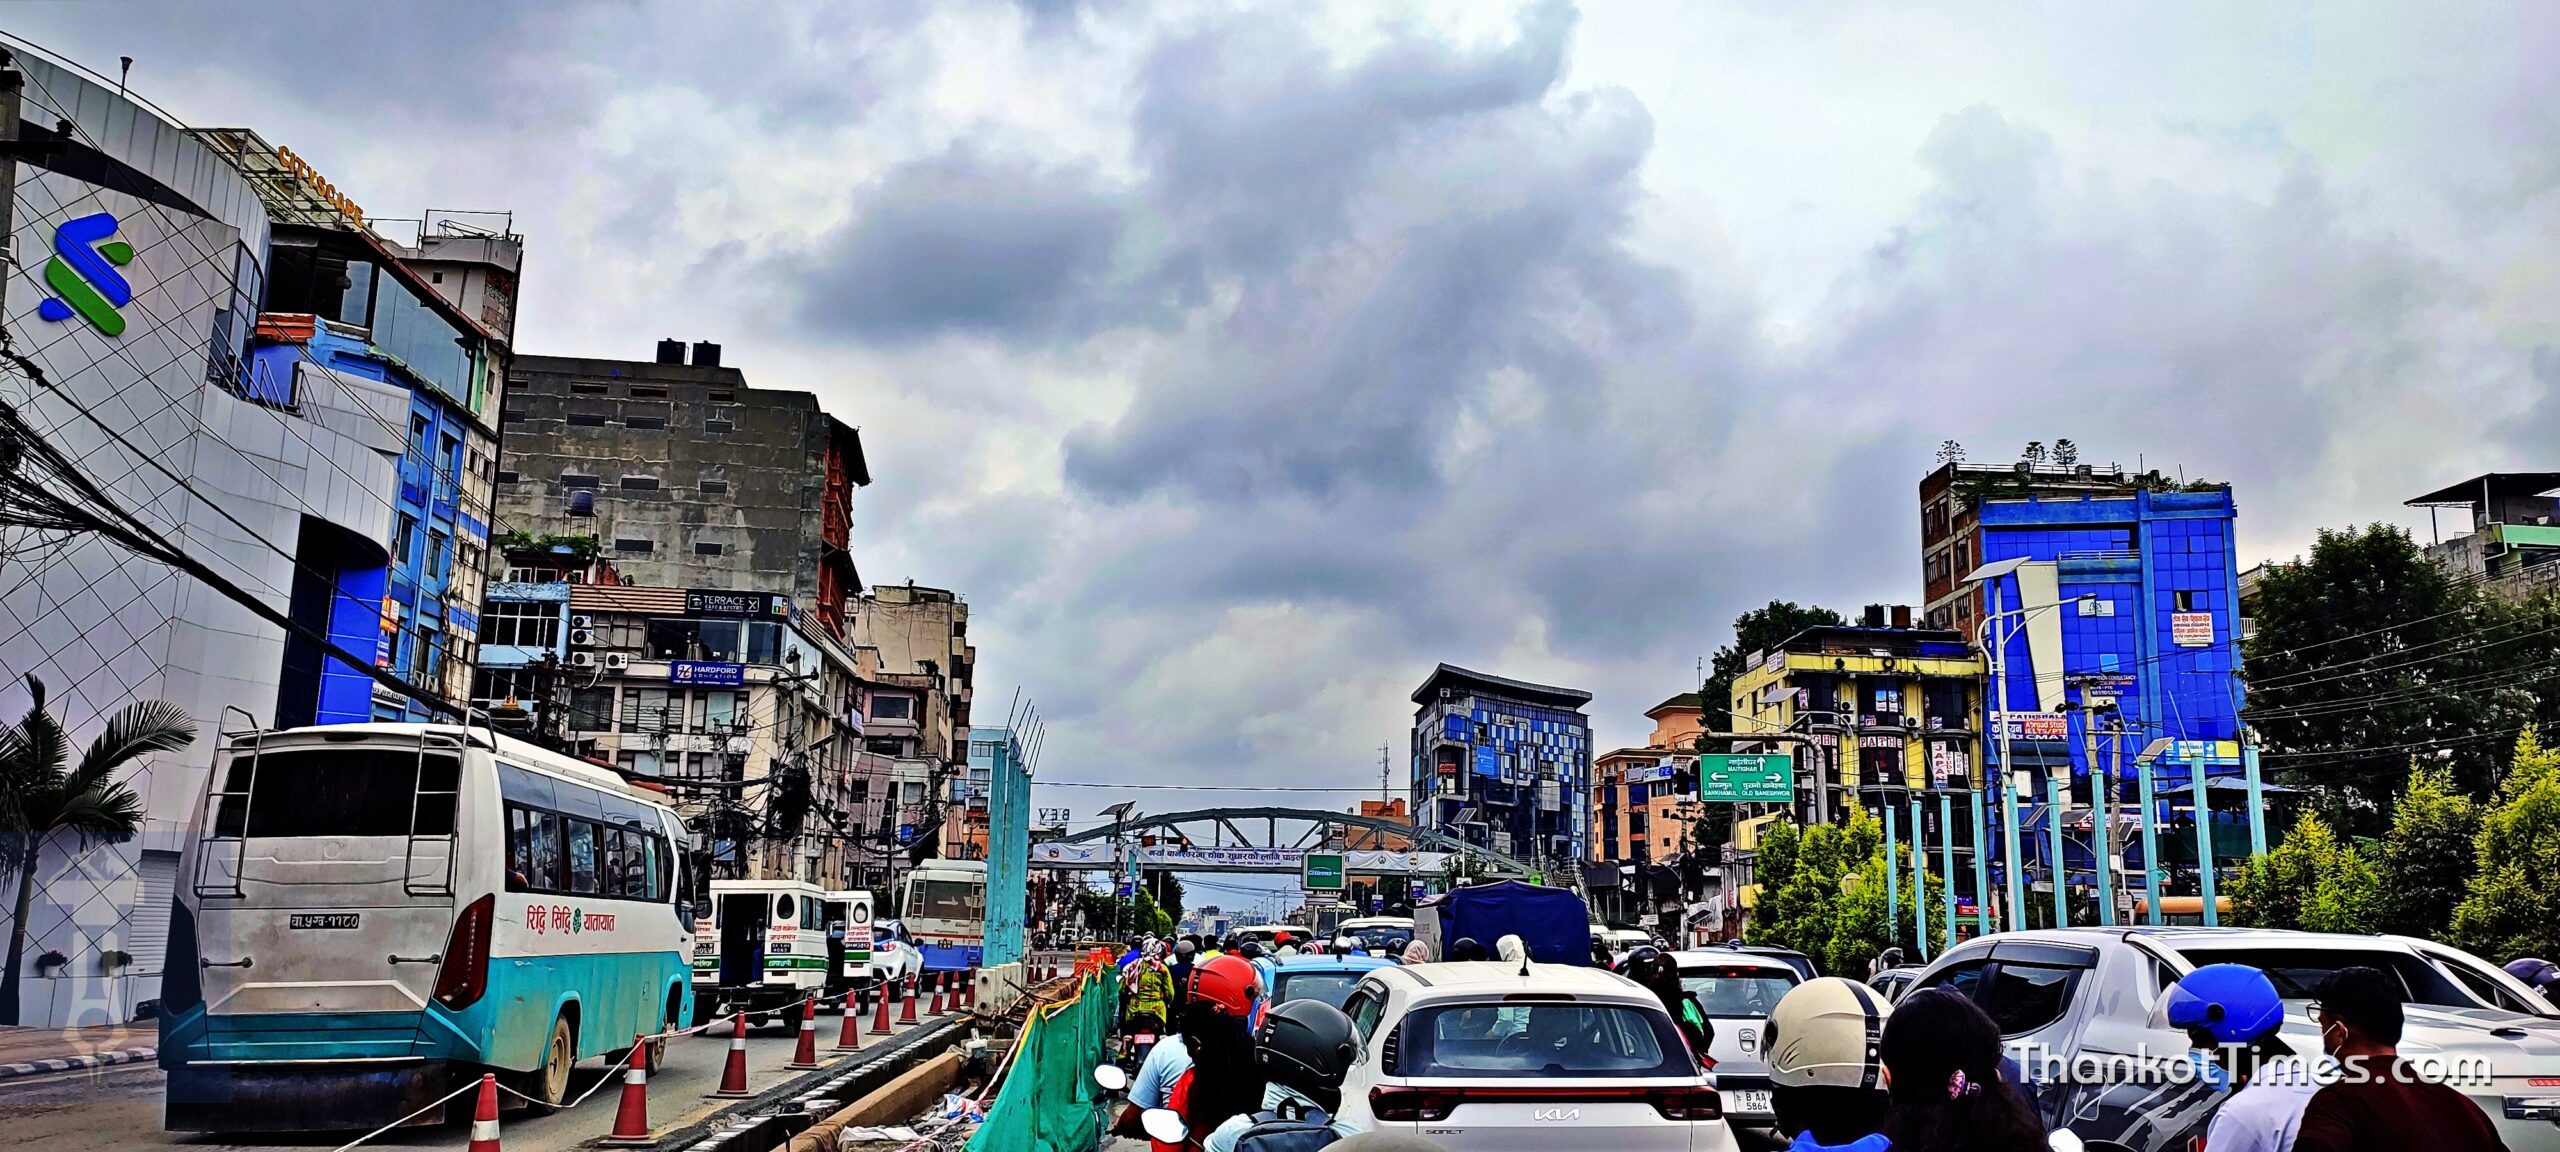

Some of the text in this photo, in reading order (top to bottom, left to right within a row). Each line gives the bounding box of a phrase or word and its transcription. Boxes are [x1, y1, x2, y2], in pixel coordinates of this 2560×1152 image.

[279, 145, 364, 228] CITYSCAPE
[703, 595, 745, 605] TERRACE
[694, 666, 738, 674] HARDFORD
[1934, 744, 1944, 783] JAPAN
[583, 914, 615, 932] यातायात
[1755, 1092, 1767, 1101] AA
[1746, 1101, 1768, 1110] 5864
[1534, 1108, 1581, 1121] KIA
